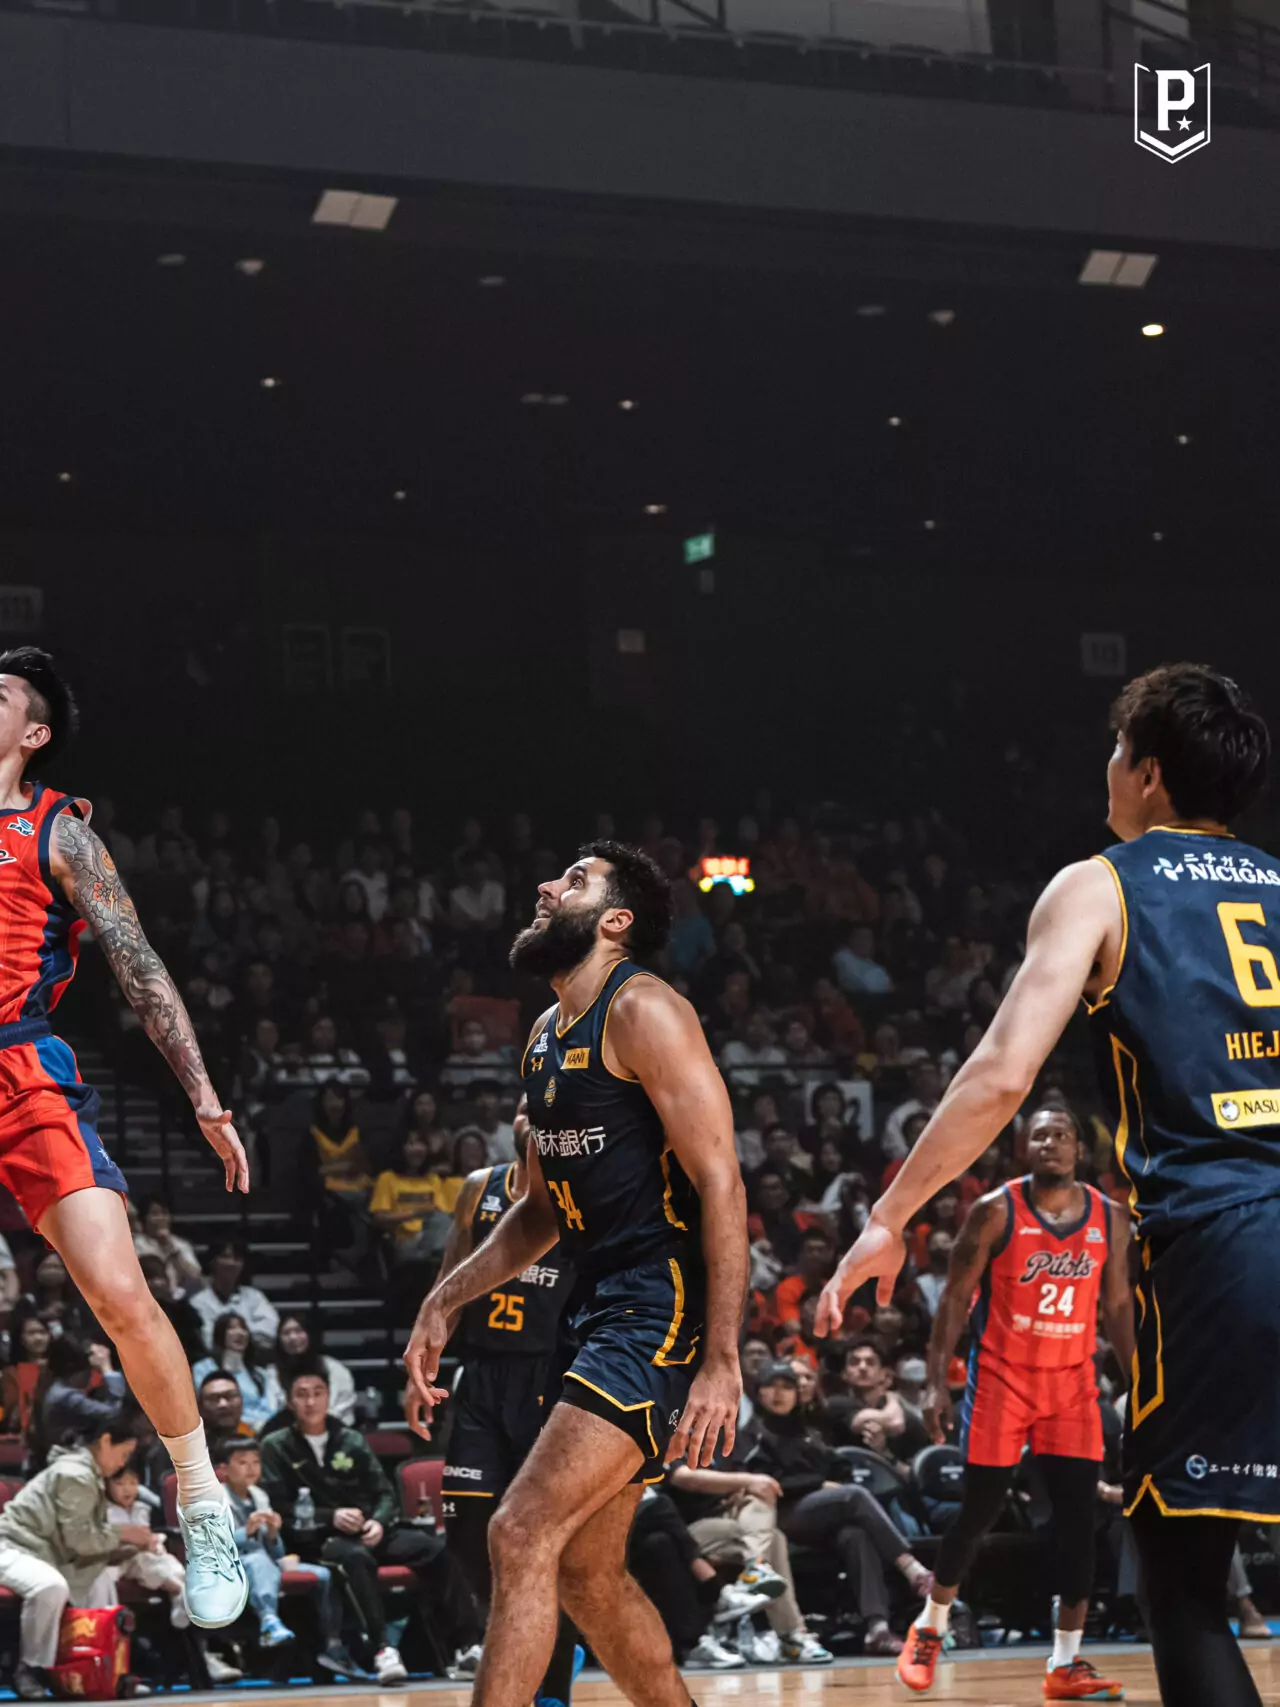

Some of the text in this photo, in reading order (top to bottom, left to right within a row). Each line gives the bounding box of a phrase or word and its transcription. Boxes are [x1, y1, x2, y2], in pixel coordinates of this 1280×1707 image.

[1183, 852, 1255, 868] ニチガス
[1216, 902, 1280, 1007] 6
[1243, 1099, 1280, 1115] NASU
[1019, 1250, 1099, 1283] Pilots
[488, 1292, 525, 1332] 25
[1037, 1283, 1075, 1317] 24
